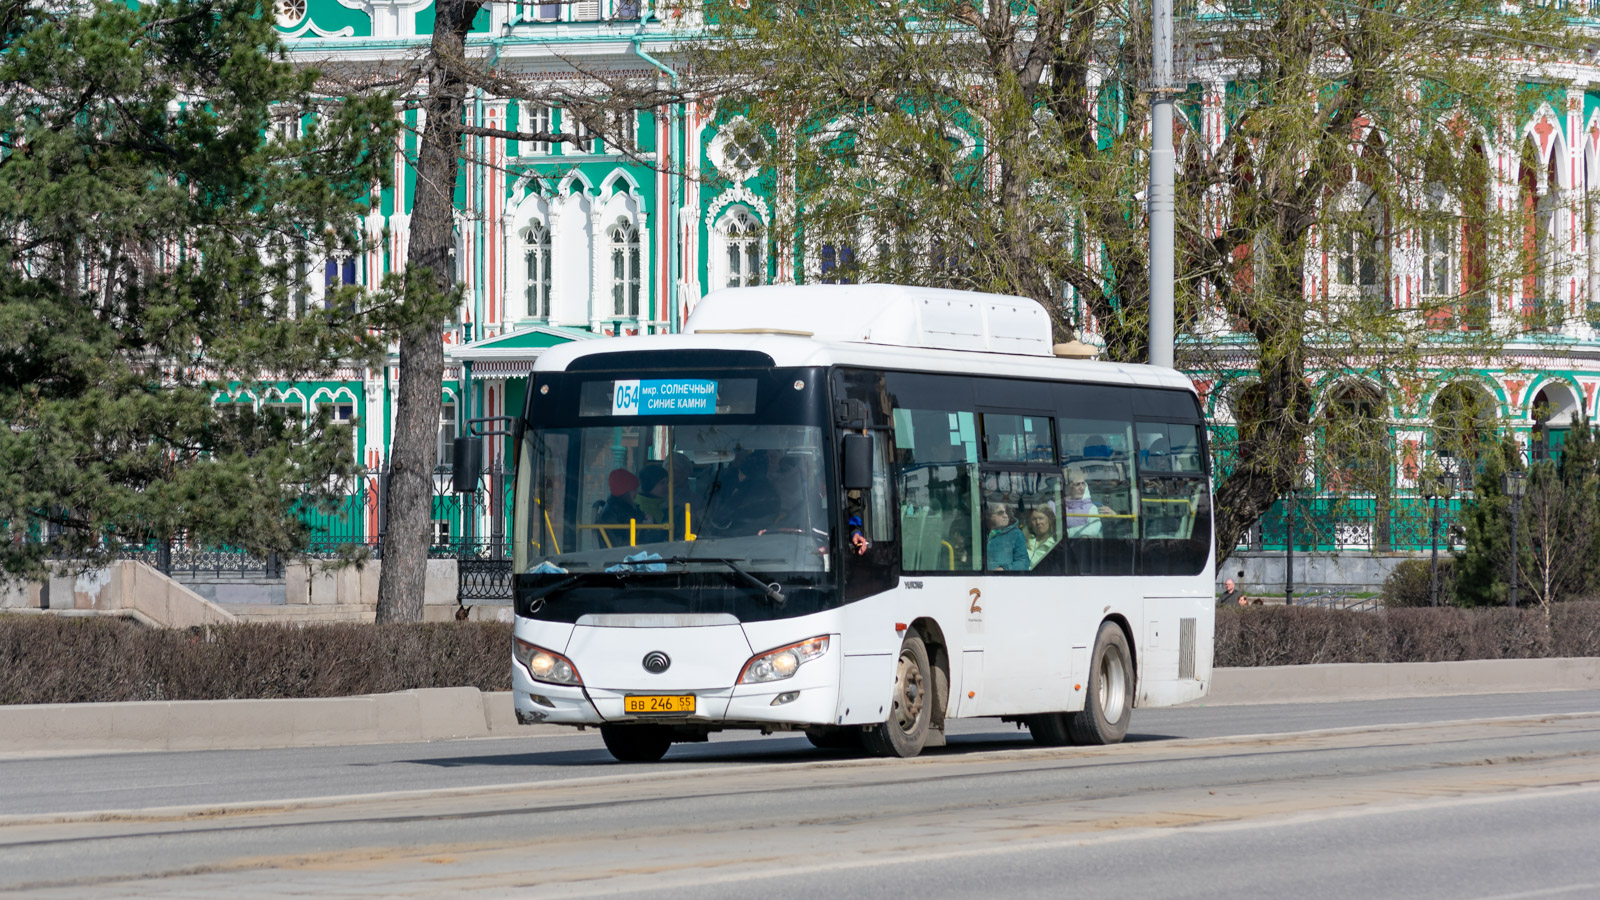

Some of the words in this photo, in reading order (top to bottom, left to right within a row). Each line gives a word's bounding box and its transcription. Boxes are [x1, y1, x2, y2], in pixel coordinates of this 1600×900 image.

[616, 385, 639, 408] 054
[642, 387, 659, 397] мкр.
[660, 382, 714, 395] СОЛНЕЧНЫЙ
[648, 398, 676, 409] СИНИЕ
[677, 398, 706, 409] КАМНИ
[650, 698, 672, 710] 246
[679, 697, 691, 706] 55
